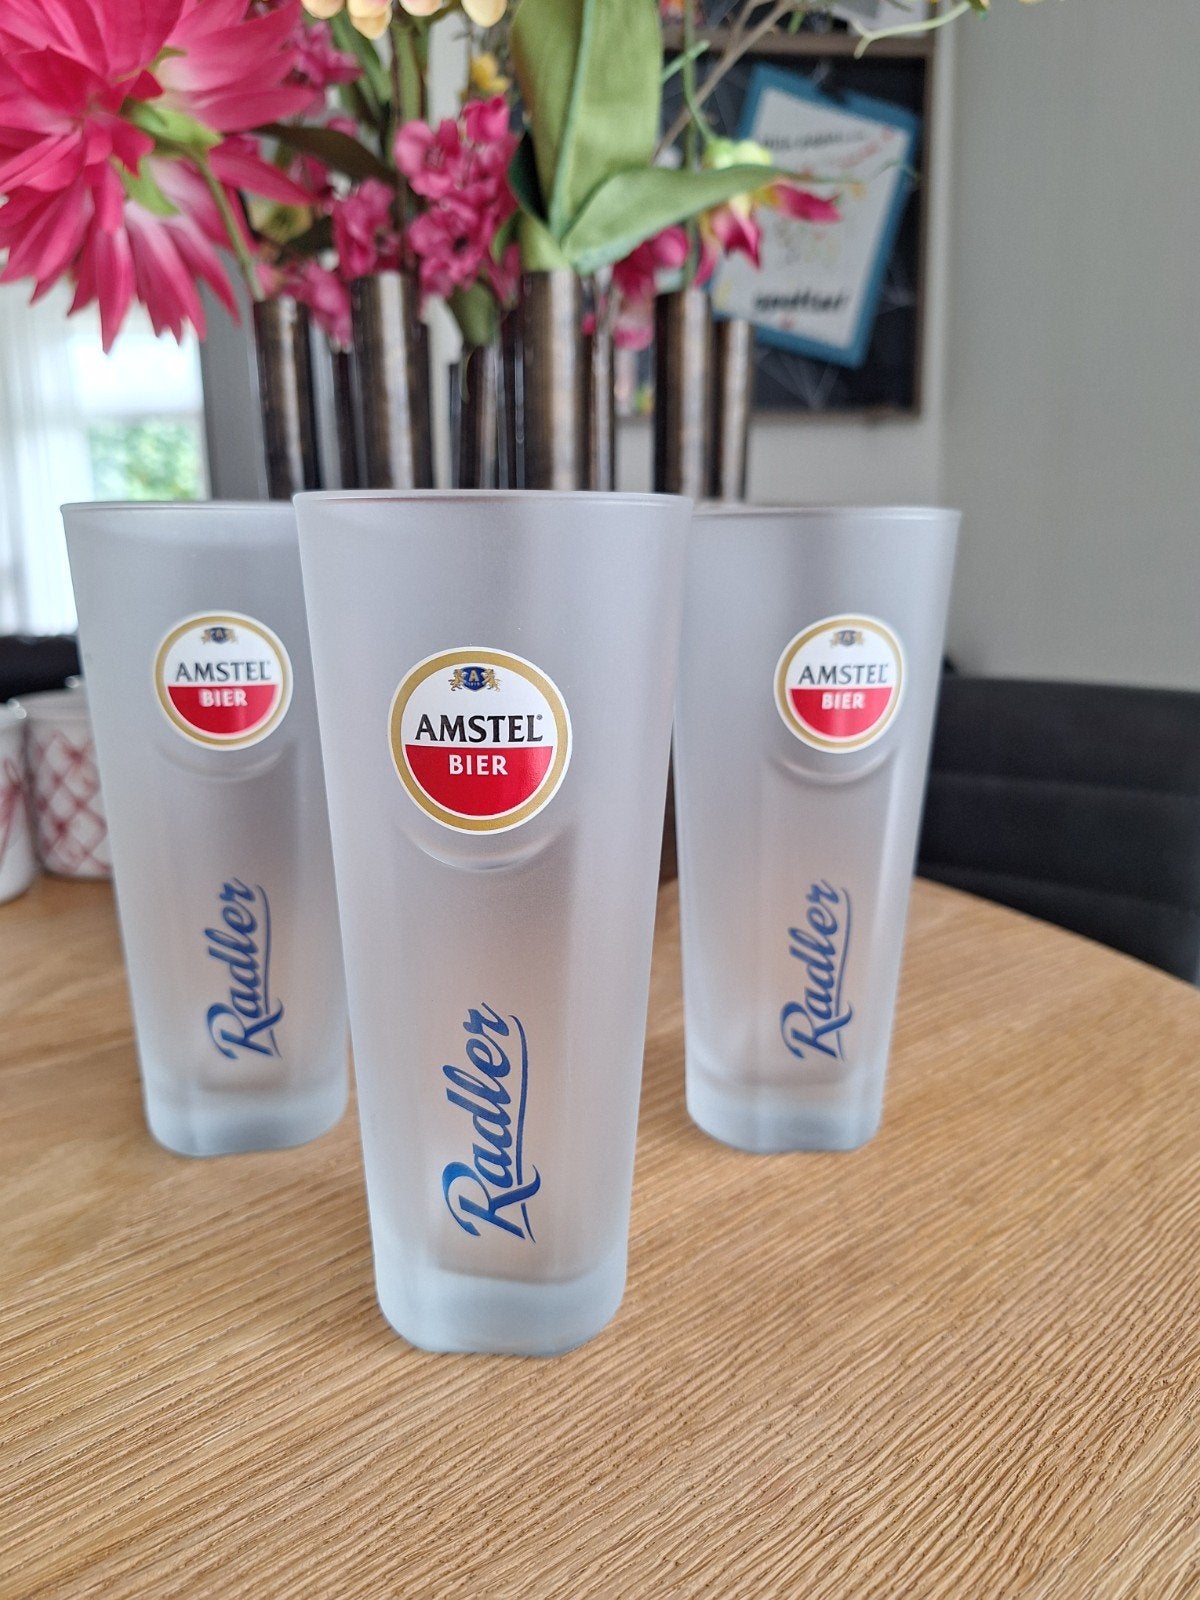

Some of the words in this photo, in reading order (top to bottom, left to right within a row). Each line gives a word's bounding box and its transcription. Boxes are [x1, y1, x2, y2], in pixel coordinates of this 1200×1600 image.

[175, 661, 272, 682] AMSTEL
[798, 664, 887, 685] AMSTEL
[199, 688, 248, 707] BIER
[822, 691, 866, 710] BIER
[415, 714, 543, 743] AMSTEL
[449, 754, 508, 776] BIER
[205, 877, 284, 1060] Radler
[780, 879, 853, 1061] Radler
[442, 1002, 541, 1241] Radler
